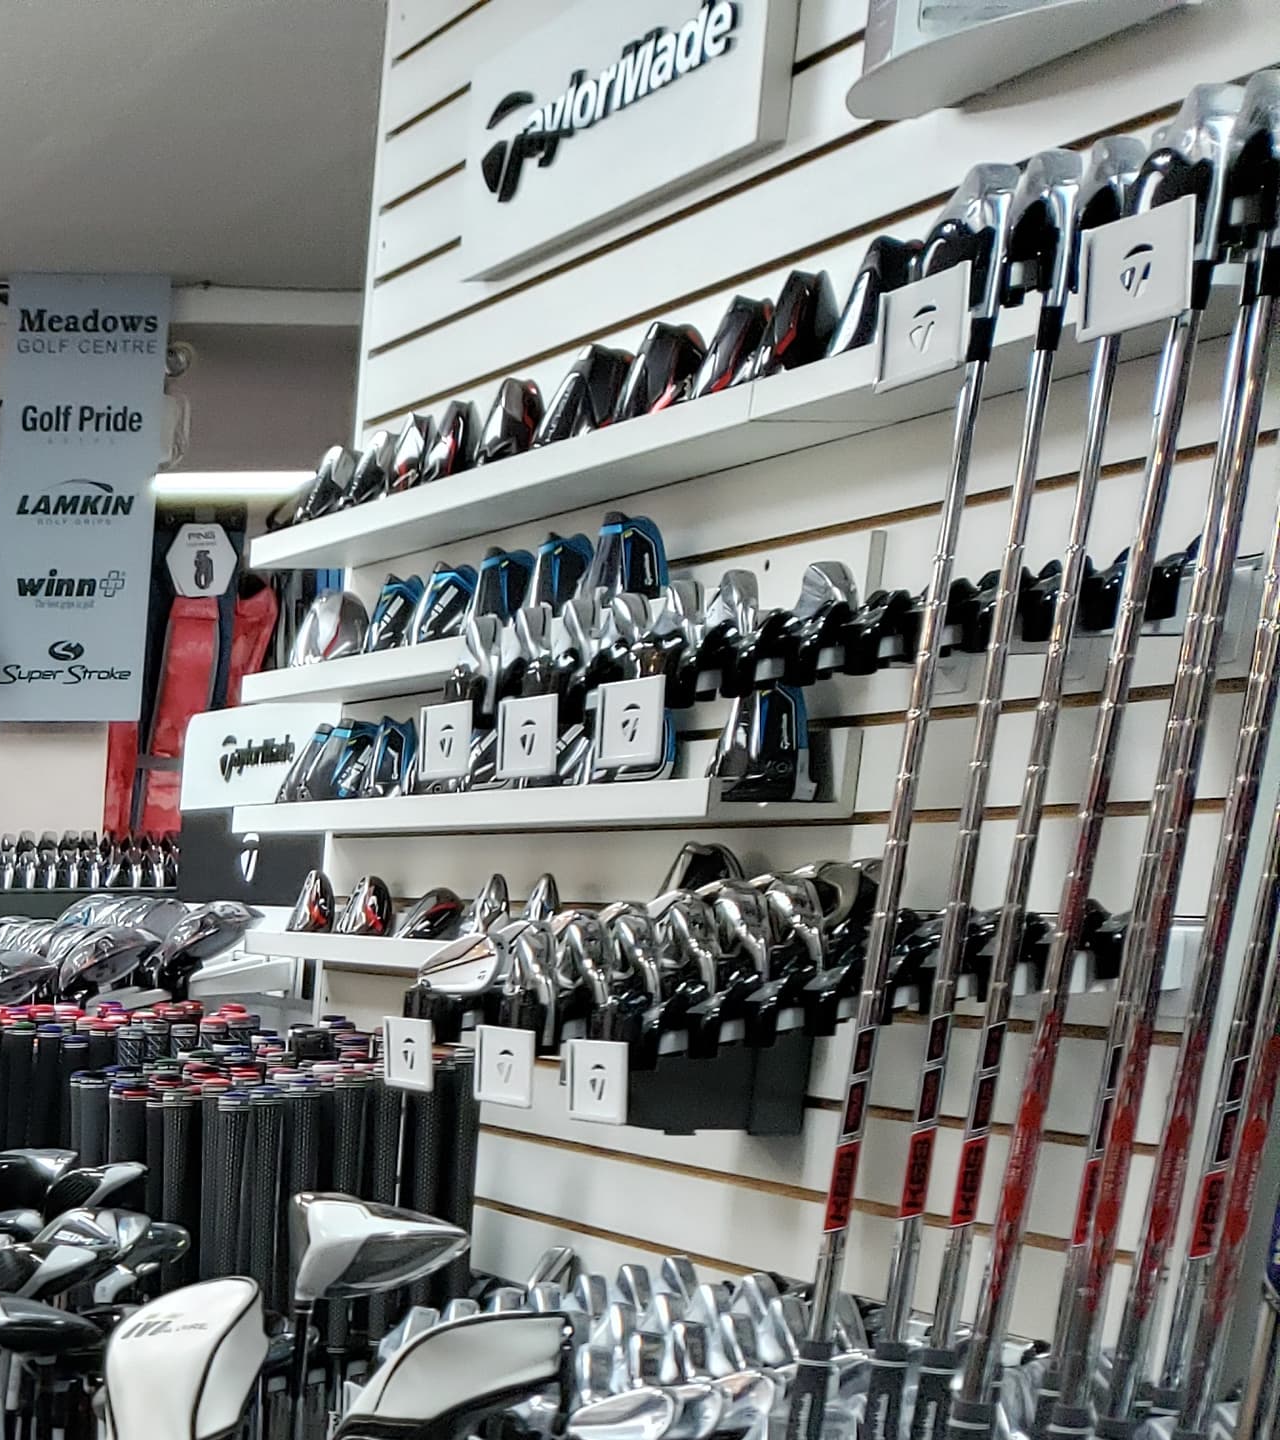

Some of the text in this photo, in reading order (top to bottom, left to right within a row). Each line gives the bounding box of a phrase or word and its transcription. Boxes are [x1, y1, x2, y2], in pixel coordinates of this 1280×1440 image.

[481, 0, 740, 202] TaylorMade
[18, 308, 158, 333] Meadows
[17, 338, 158, 354] GOLF CENTRE
[21, 405, 143, 432] Golf Pride
[16, 494, 135, 516] LAMKIN
